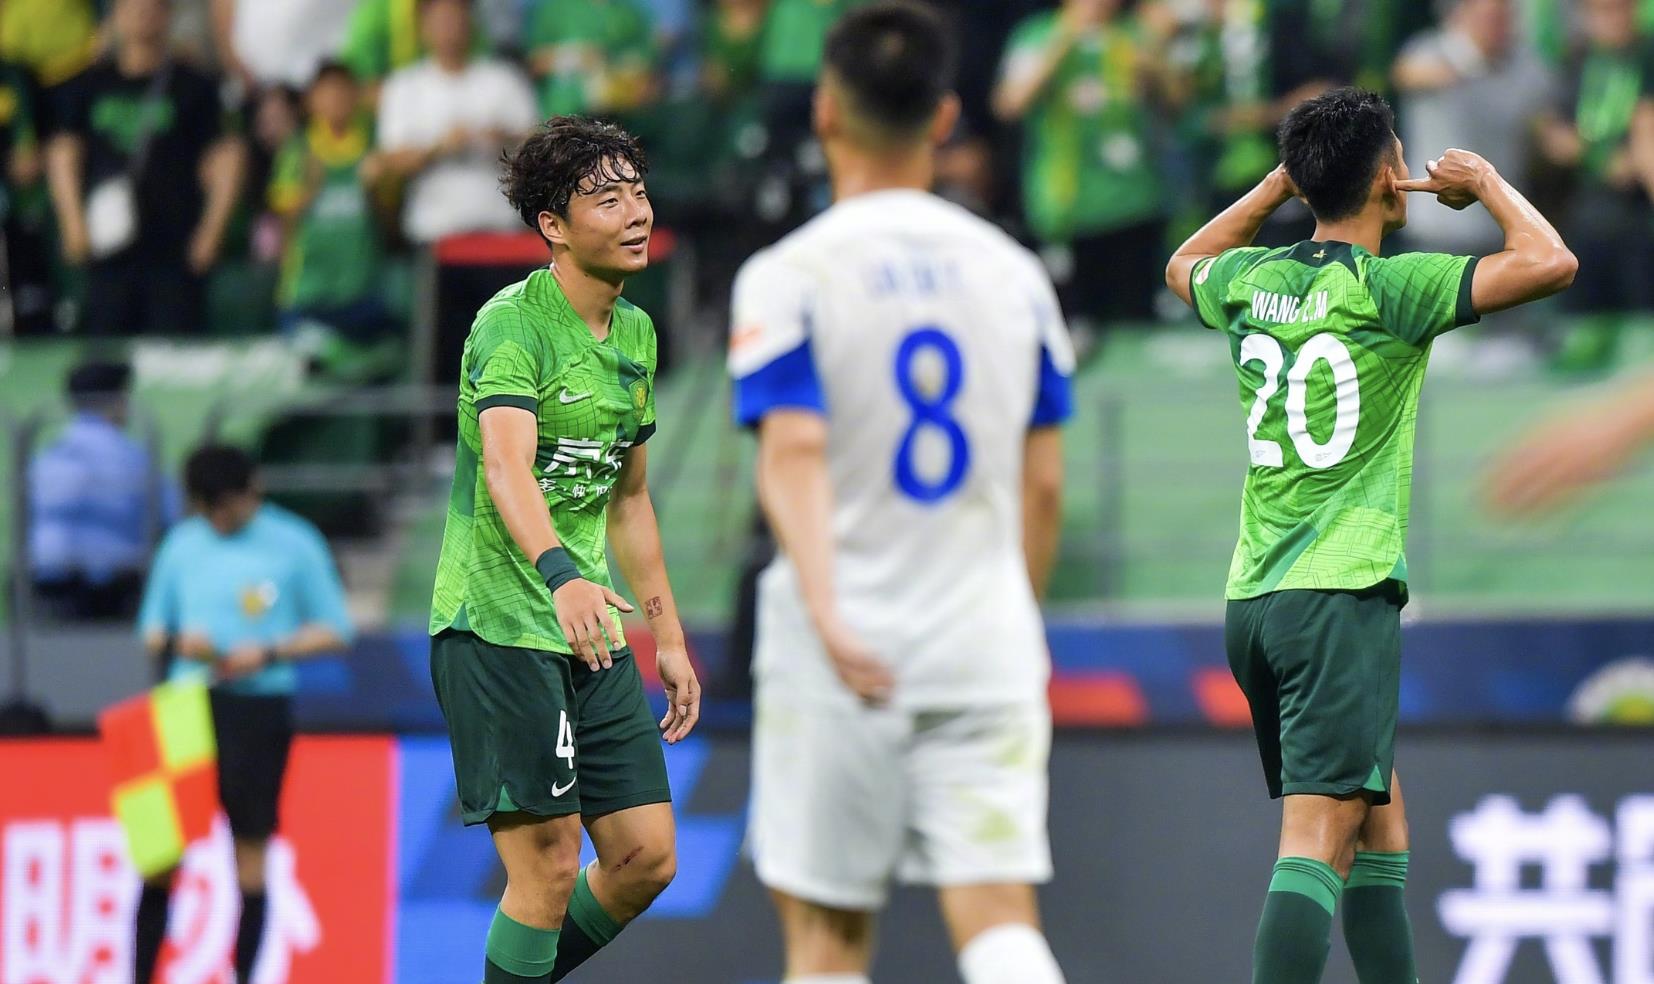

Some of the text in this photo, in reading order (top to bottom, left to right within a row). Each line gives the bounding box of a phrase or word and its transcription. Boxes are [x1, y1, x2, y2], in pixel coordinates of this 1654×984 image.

[1252, 291, 1300, 324] WANG
[894, 325, 970, 504] 8
[1240, 333, 1360, 468] 20
[555, 709, 575, 769] 4
[1437, 795, 1654, 984] 共
